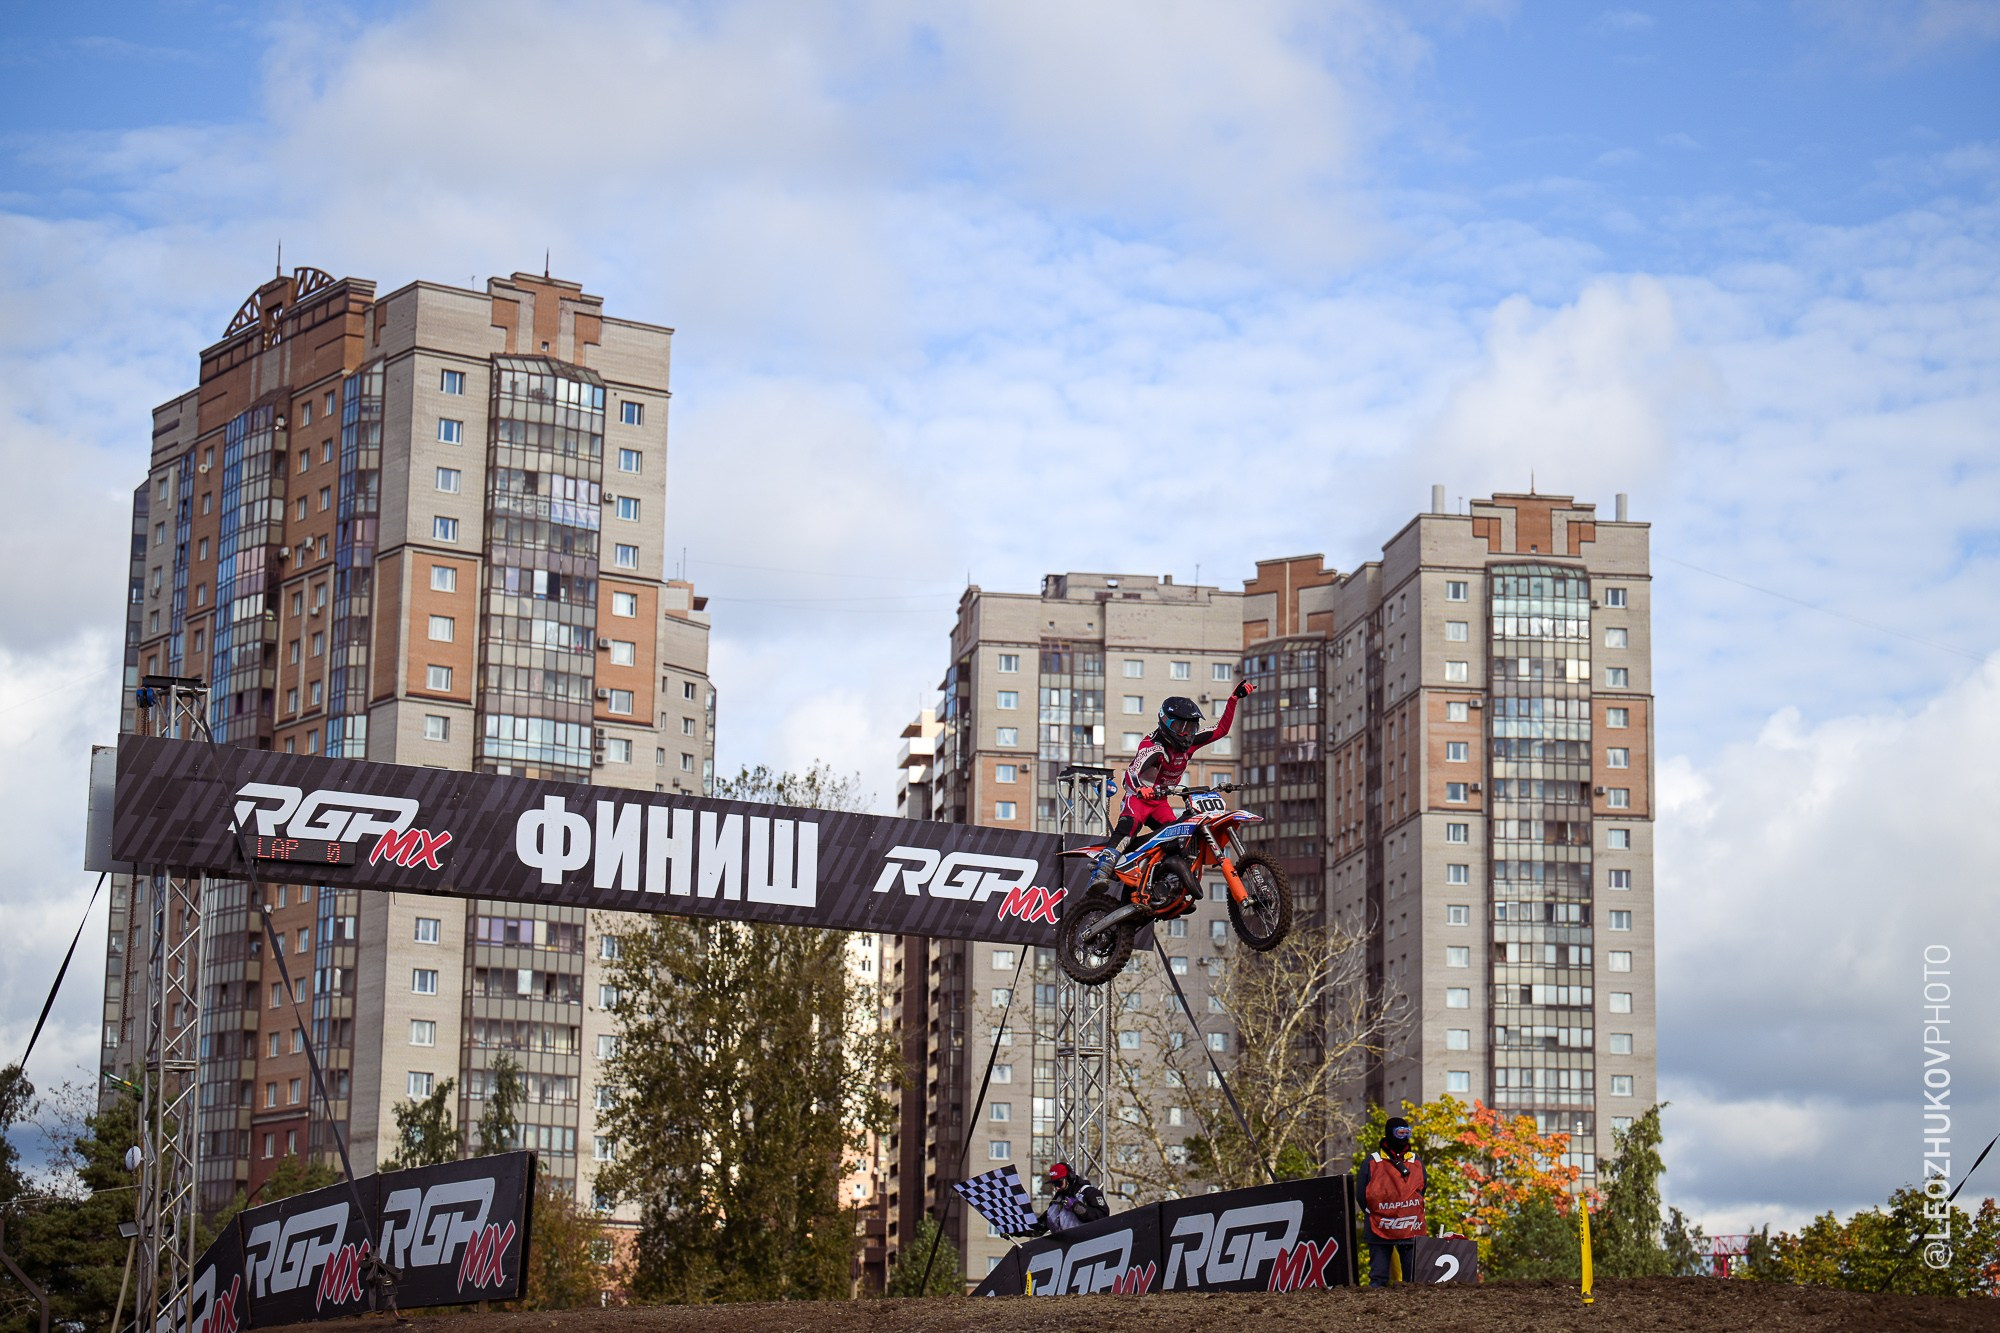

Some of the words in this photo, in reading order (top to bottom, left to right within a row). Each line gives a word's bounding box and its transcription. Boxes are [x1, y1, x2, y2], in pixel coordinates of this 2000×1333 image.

[227, 782, 420, 843] RGP
[368, 827, 453, 870] MX
[1196, 798, 1225, 813] 100
[257, 837, 299, 860] LAP
[327, 842, 340, 863] 0
[515, 795, 819, 908] ФИНИШ
[872, 845, 1039, 902] RGP
[997, 885, 1069, 925] MX
[246, 1202, 350, 1299] RGP
[315, 1238, 370, 1313] MX
[382, 1177, 495, 1269] RGP
[457, 1220, 516, 1295] MX
[1162, 1200, 1304, 1290] RGP
[1268, 1236, 1339, 1293] MX
[1434, 1253, 1460, 1283] 2
